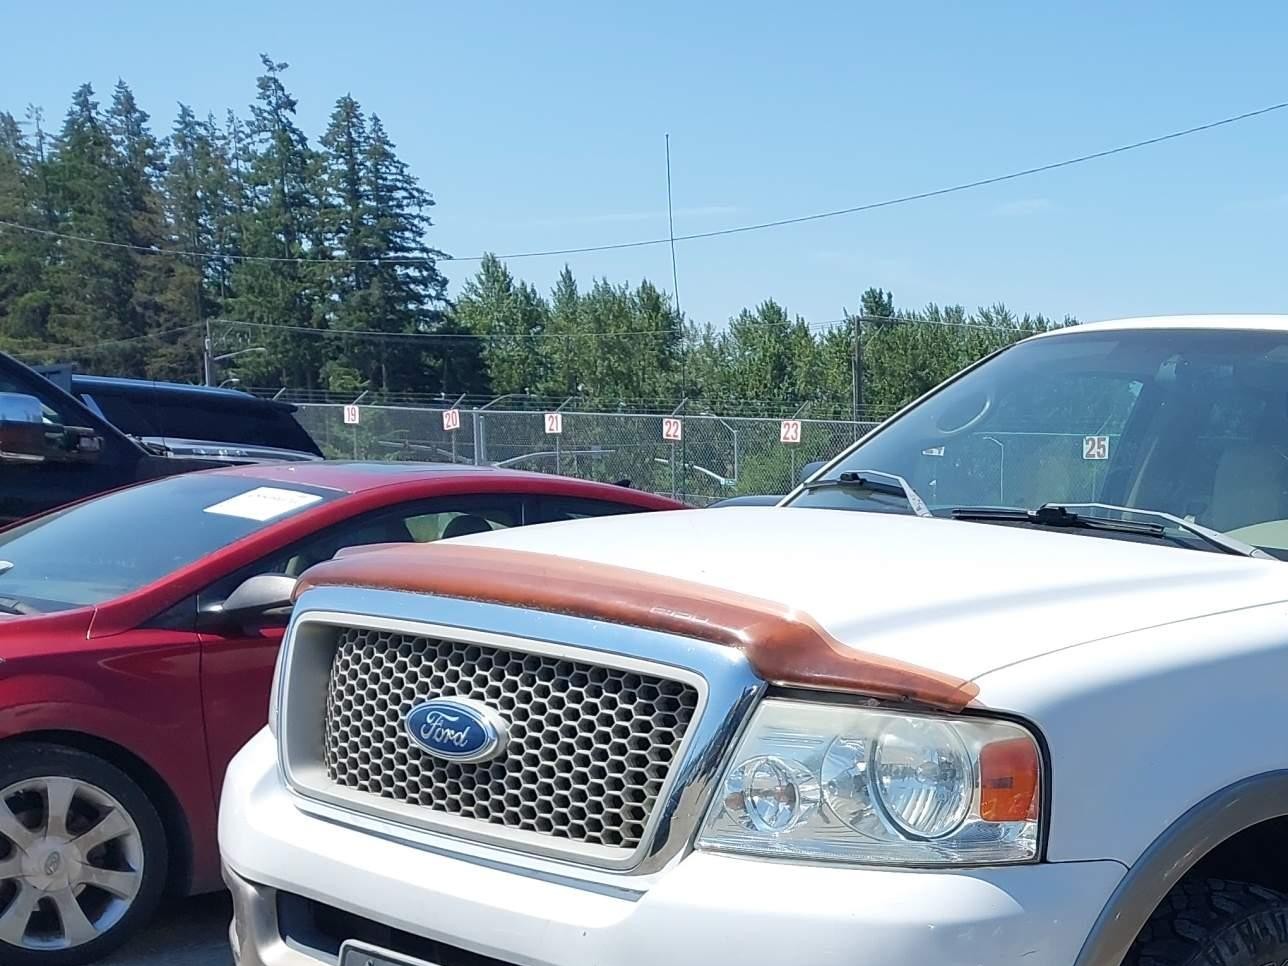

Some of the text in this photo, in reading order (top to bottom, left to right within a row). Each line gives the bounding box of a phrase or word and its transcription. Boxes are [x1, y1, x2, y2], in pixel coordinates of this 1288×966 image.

[346, 406, 357, 422] 19
[444, 410, 458, 429] 20
[547, 415, 559, 432] 21
[664, 420, 680, 438] 22
[782, 421, 799, 441] 23
[1085, 437, 1107, 458] 25
[420, 710, 472, 747] Ford
